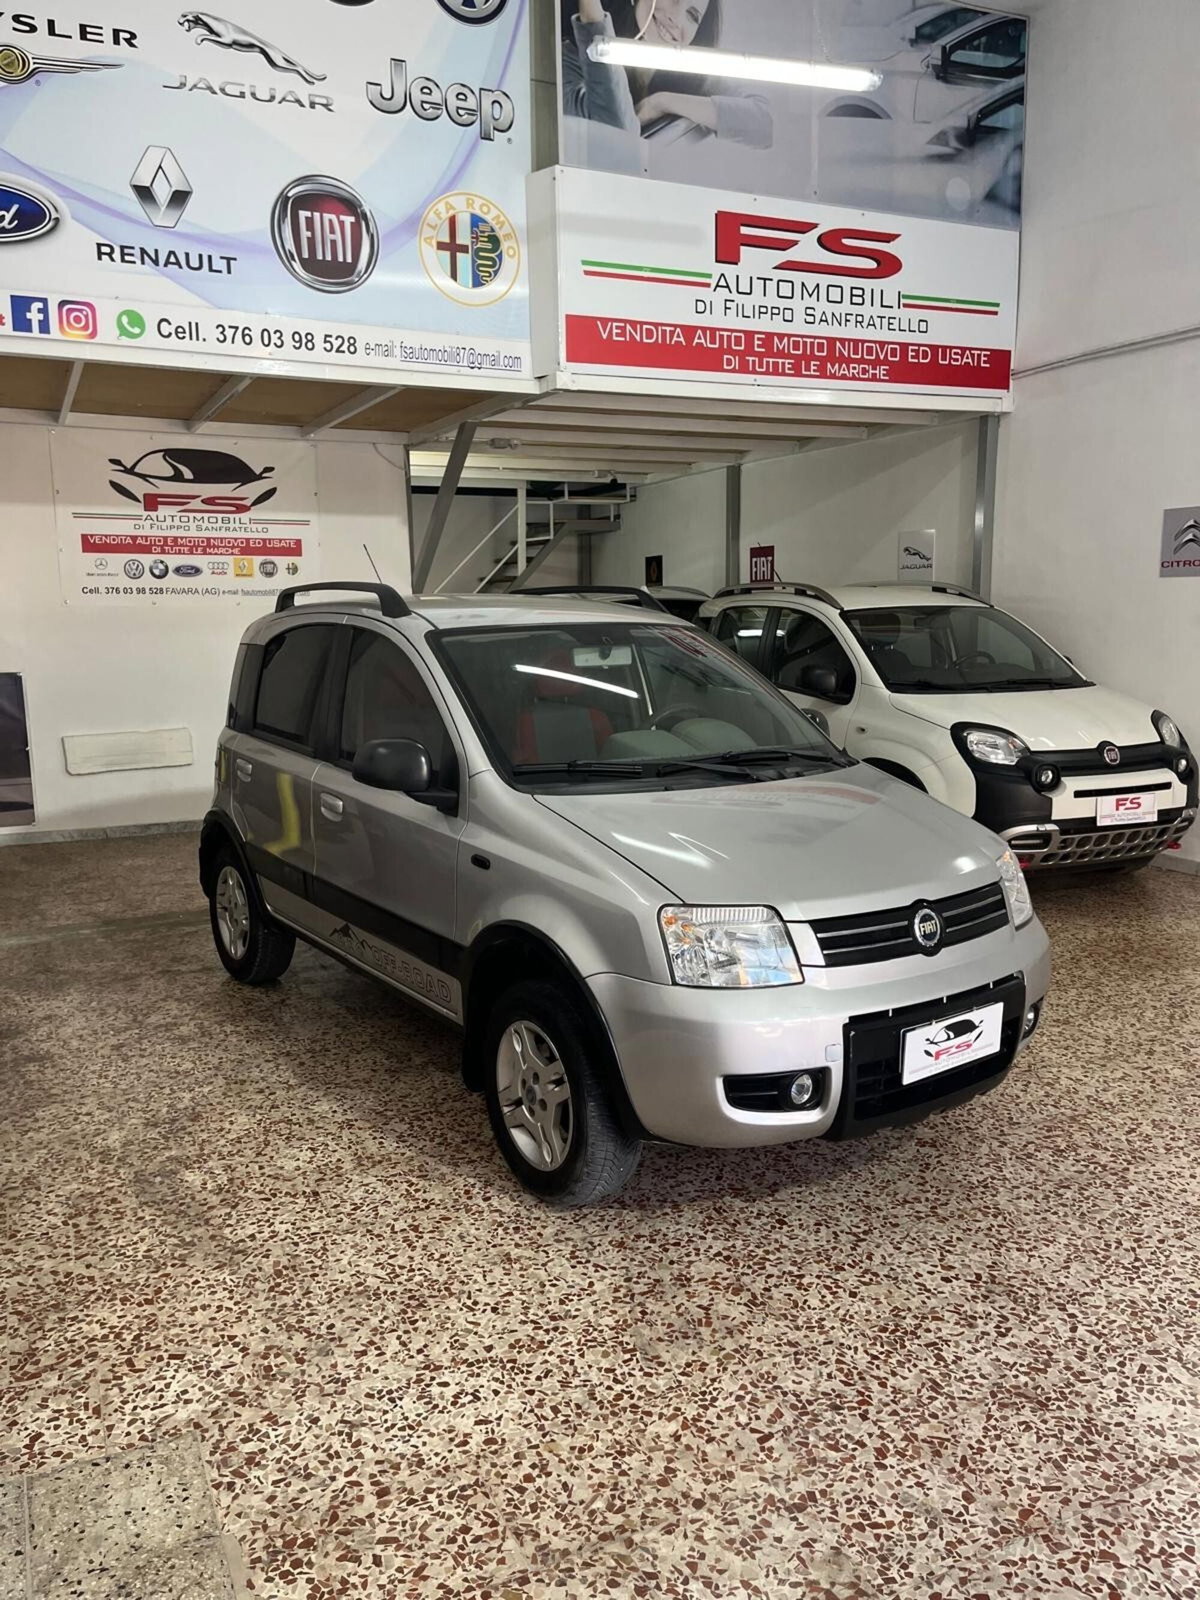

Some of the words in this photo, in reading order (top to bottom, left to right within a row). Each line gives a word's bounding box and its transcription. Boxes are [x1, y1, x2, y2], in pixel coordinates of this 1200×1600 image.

[162, 75, 335, 112] JAGUAR
[366, 58, 515, 141] Jeep
[298, 210, 356, 263] FIAT
[423, 200, 457, 248] ALFA
[465, 197, 517, 258] ROMEO
[95, 242, 237, 275] RENAULT
[715, 210, 903, 279] FS
[713, 273, 901, 309] AUTOMOBILI
[695, 299, 712, 315] DI
[724, 299, 793, 322] FILIPPO
[804, 307, 928, 333] SANFRATELLO
[157, 318, 207, 342] Cell.
[215, 324, 253, 346] 376
[260, 328, 284, 348] 03
[292, 331, 315, 351] 98
[323, 334, 358, 355] 528
[364, 341, 397, 358] e-mail:
[400, 341, 522, 369] fsautomobili87@gmail.com
[597, 321, 685, 346] VENDITA
[693, 329, 745, 350] AUTO
[754, 334, 765, 352] E
[774, 336, 827, 357] MOTO
[836, 341, 900, 361] NUOVO
[908, 346, 931, 363] ED
[938, 349, 990, 367] USATE
[723, 355, 739, 370] DI
[746, 357, 794, 374] TUTTE
[802, 361, 820, 375] LE
[827, 363, 889, 380] MARCHE
[143, 493, 252, 514] FS
[143, 514, 252, 525] AUTOMOBILI
[88, 535, 133, 544] VENDITA
[136, 537, 164, 545] AUTO
[167, 537, 174, 545] E
[177, 537, 207, 546] MOTO
[210, 538, 246, 547] NUOVO
[249, 539, 263, 547] ED
[266, 539, 297, 548] USATE
[164, 546, 190, 554] TUTTE
[206, 547, 241, 555] MARCHE
[752, 557, 773, 581] FIAT
[81, 586, 102, 595] Cell.
[104, 587, 121, 595] 376
[122, 587, 134, 595] 03
[135, 587, 147, 595] 98
[148, 587, 165, 595] 528
[165, 587, 200, 595] FAVARA
[201, 587, 220, 597] (AG)
[1115, 797, 1142, 811] FS
[919, 920, 937, 935] FIAT
[934, 1039, 974, 1061] FS
